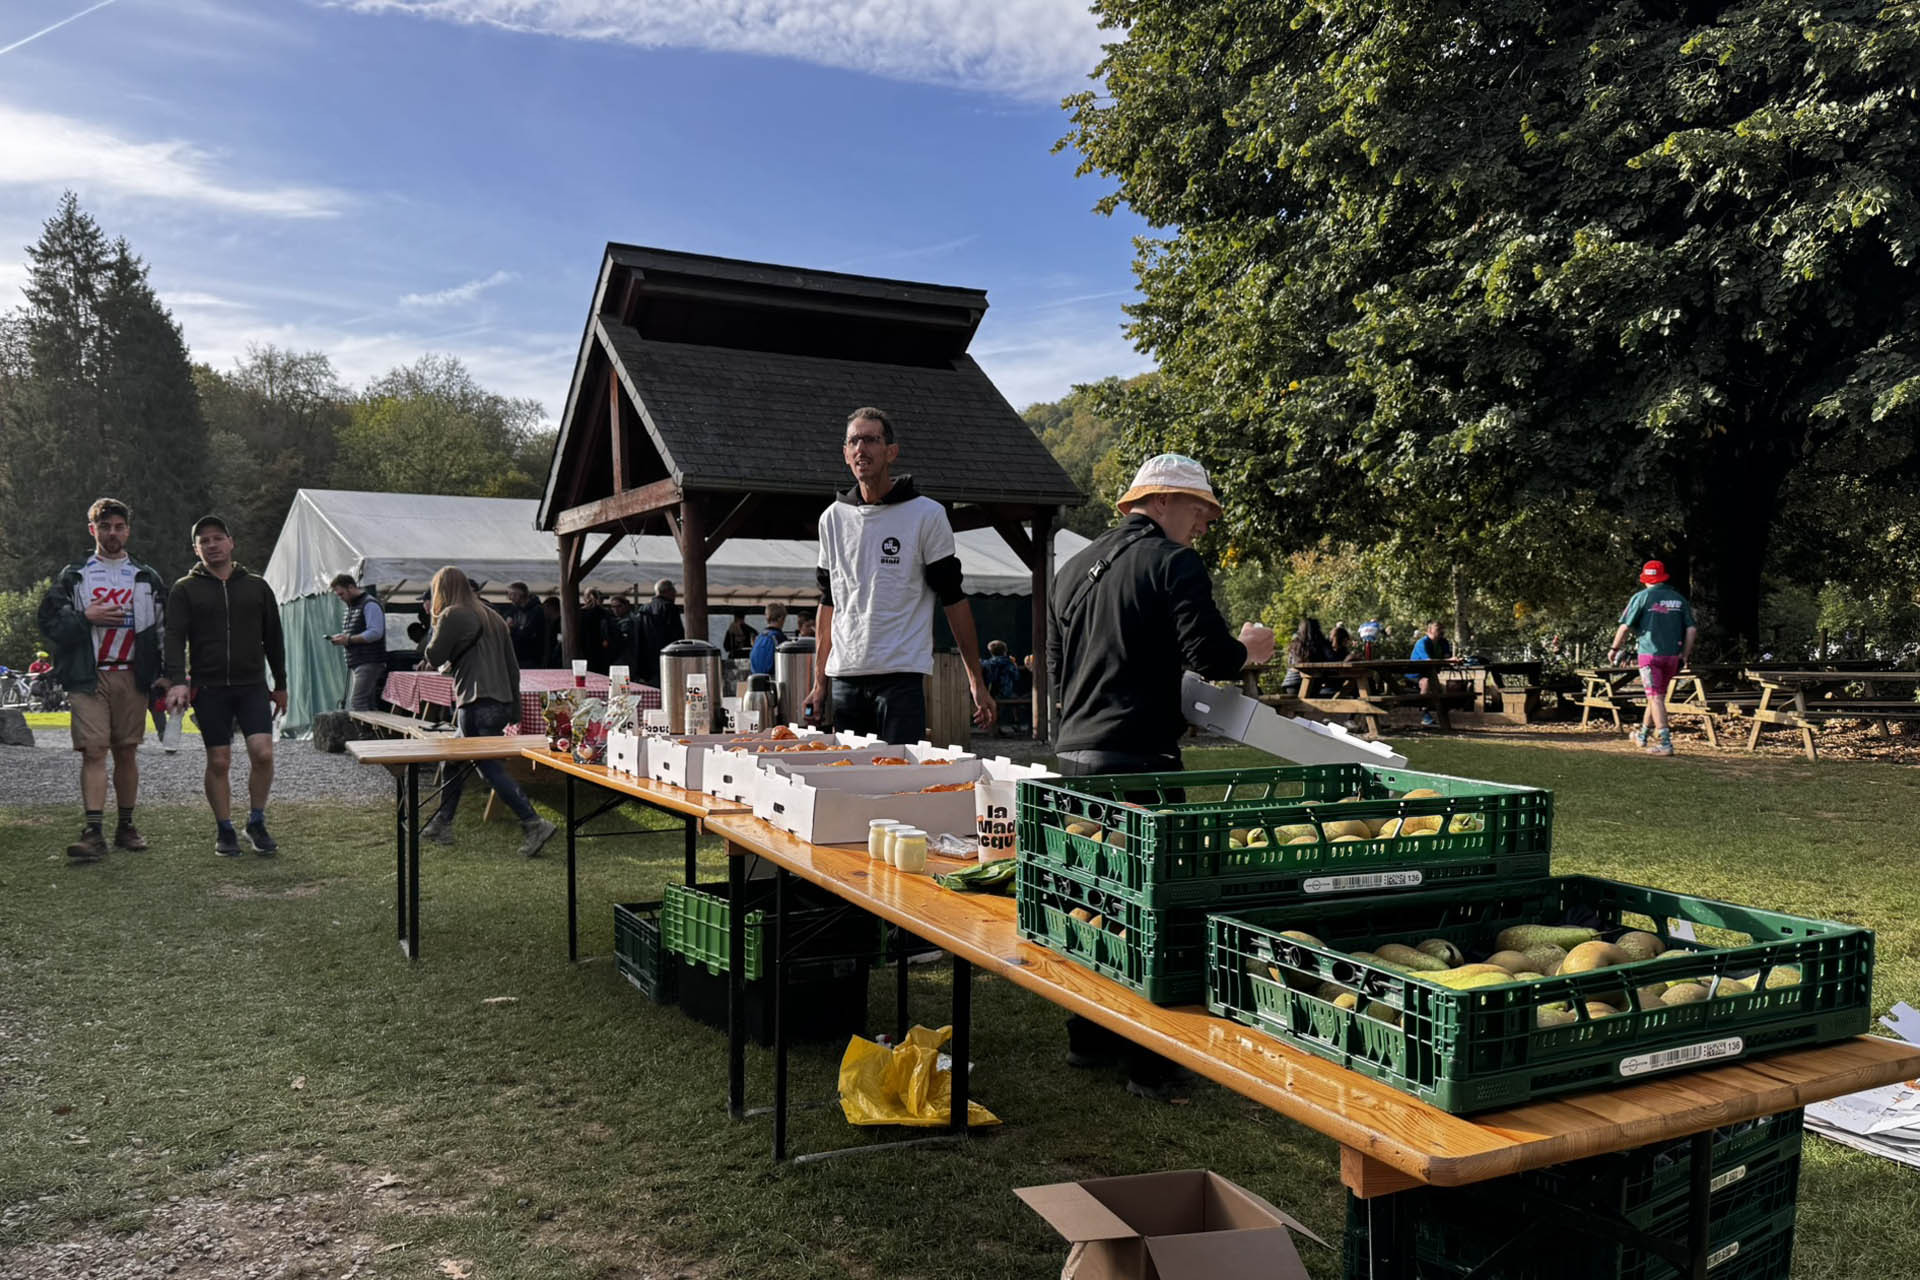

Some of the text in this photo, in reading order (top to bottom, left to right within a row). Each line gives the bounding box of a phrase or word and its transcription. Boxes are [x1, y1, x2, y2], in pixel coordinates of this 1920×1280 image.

[91, 587, 134, 605] SKI
[988, 805, 1007, 818] la
[1728, 1040, 1741, 1052] 136
